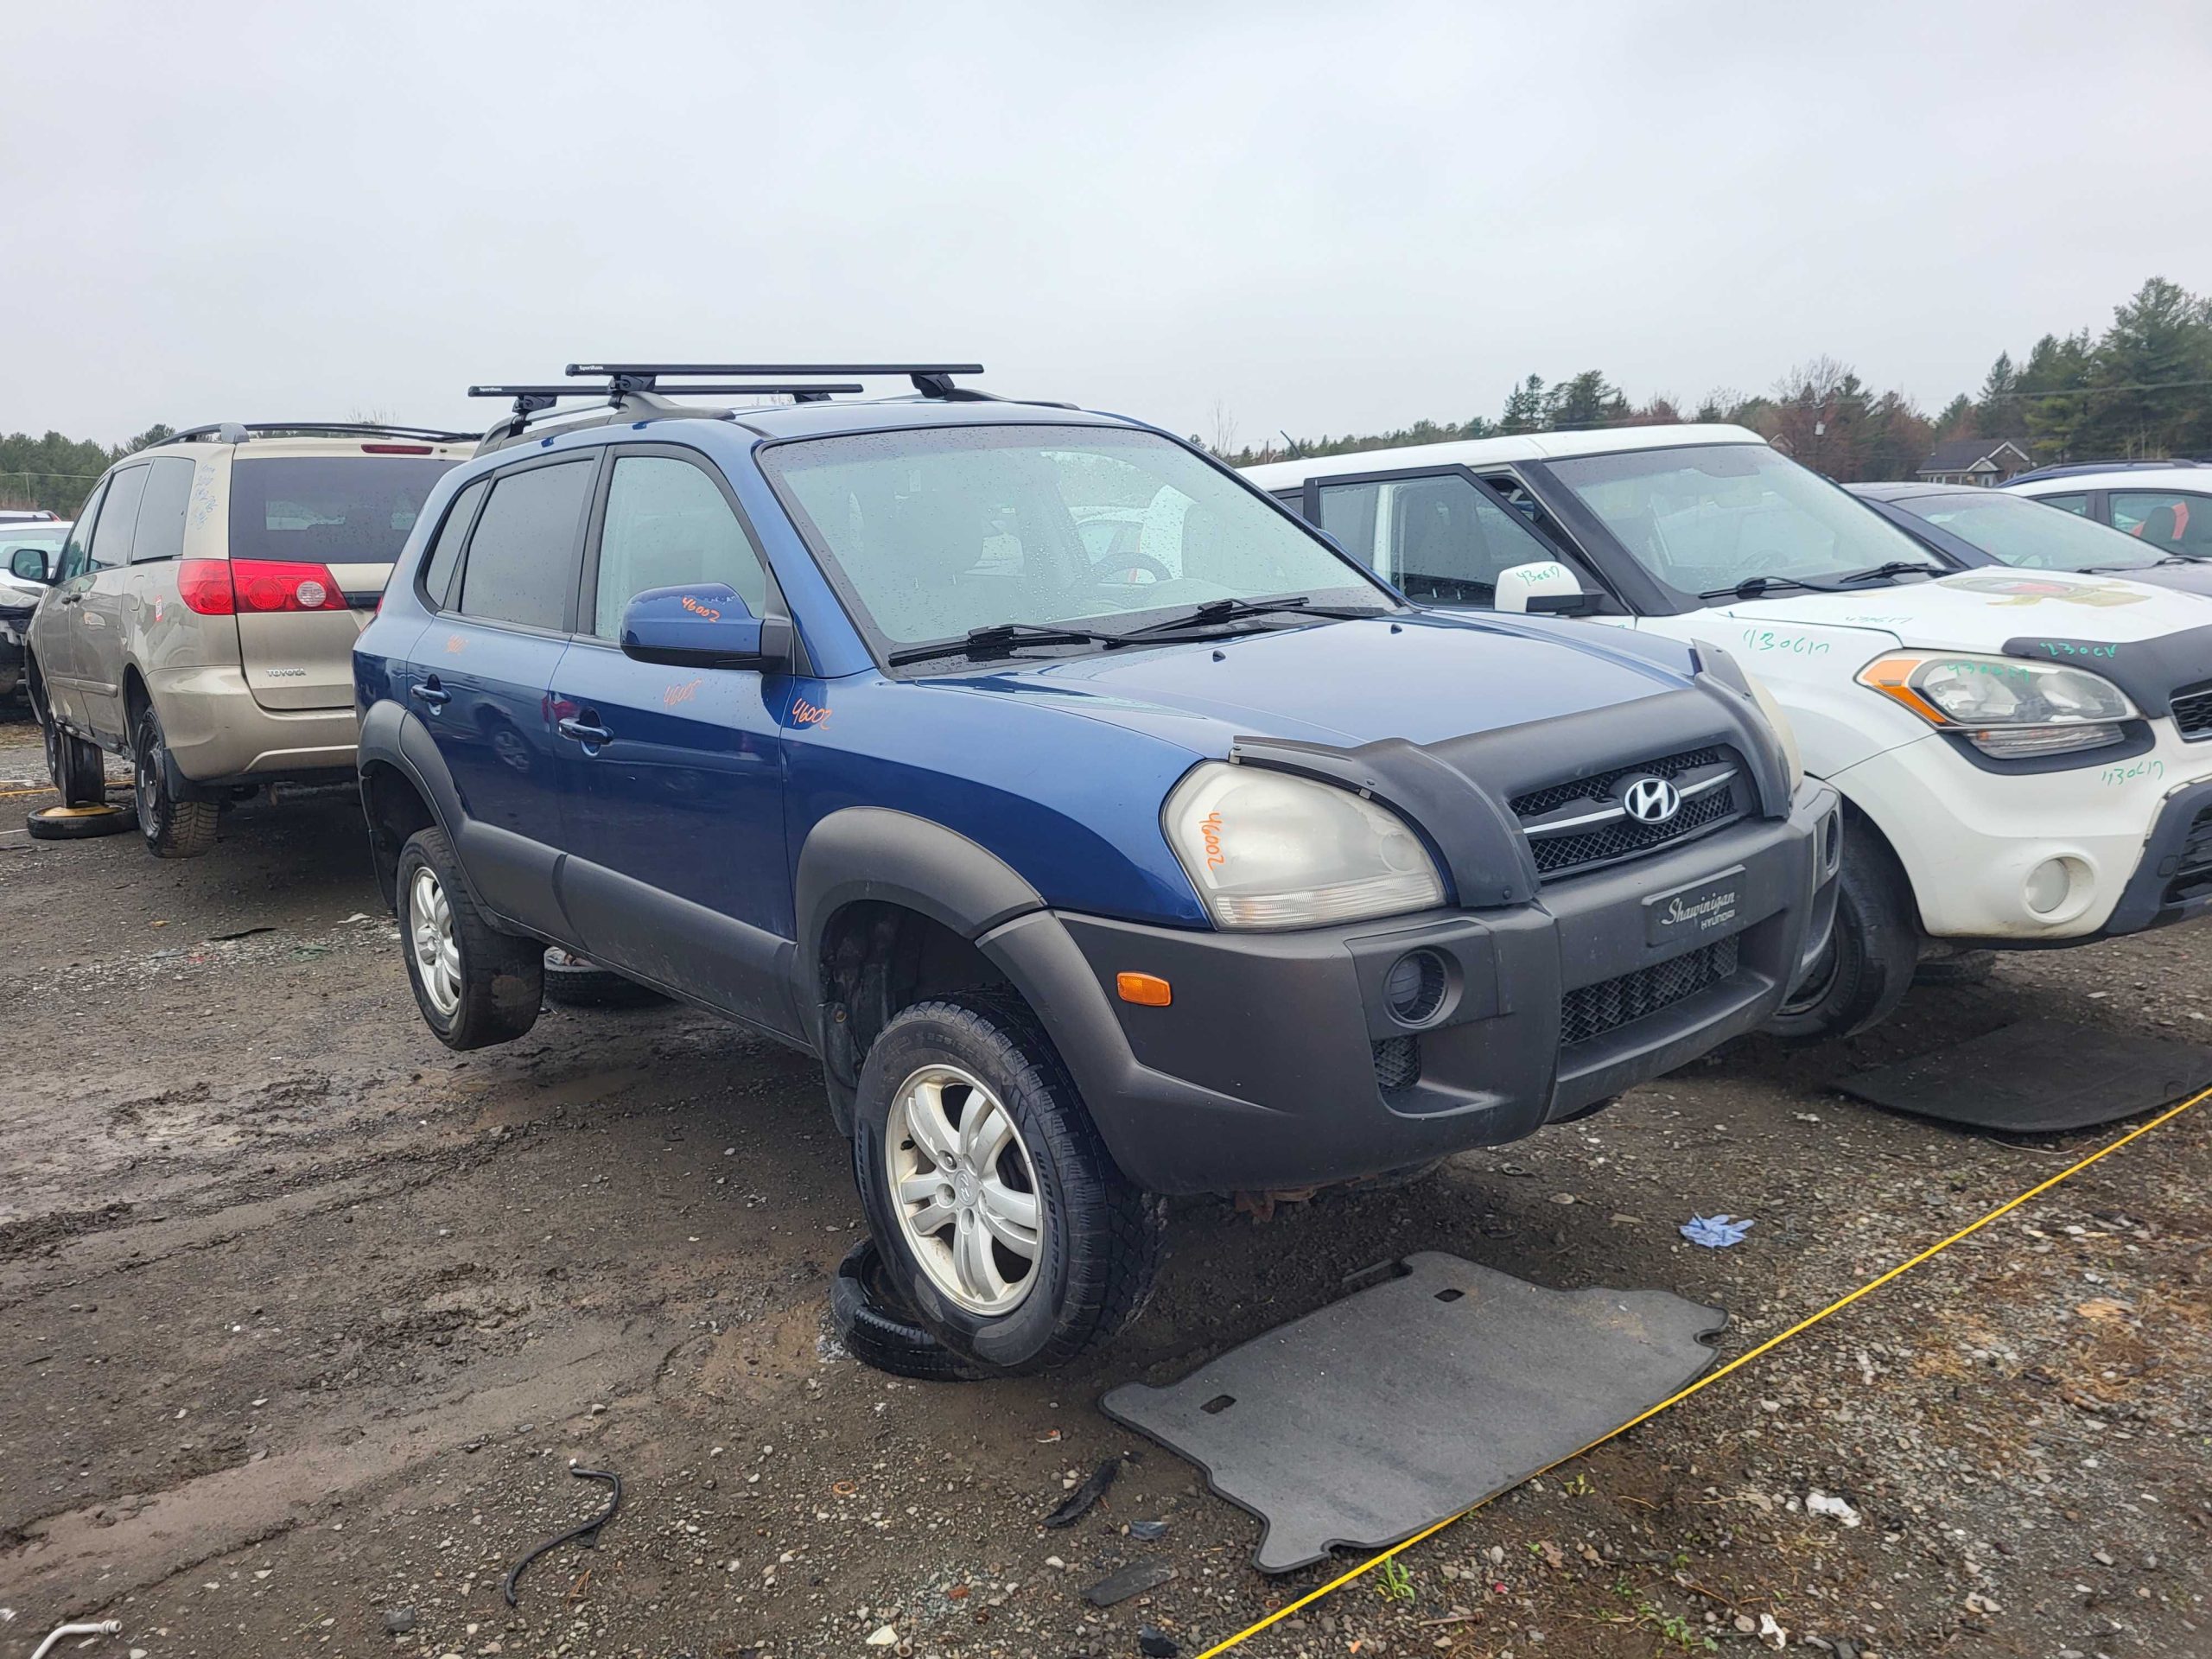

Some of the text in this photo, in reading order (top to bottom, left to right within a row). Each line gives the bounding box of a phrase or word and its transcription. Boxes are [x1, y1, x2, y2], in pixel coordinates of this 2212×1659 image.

[682, 596, 721, 623] 46002
[266, 668, 306, 677] TOYOTA
[791, 697, 833, 730] 46002
[1198, 812, 1224, 871] 46002
[1661, 892, 1735, 925] Shawinigan
[1700, 909, 1736, 931] HYUNDAI
